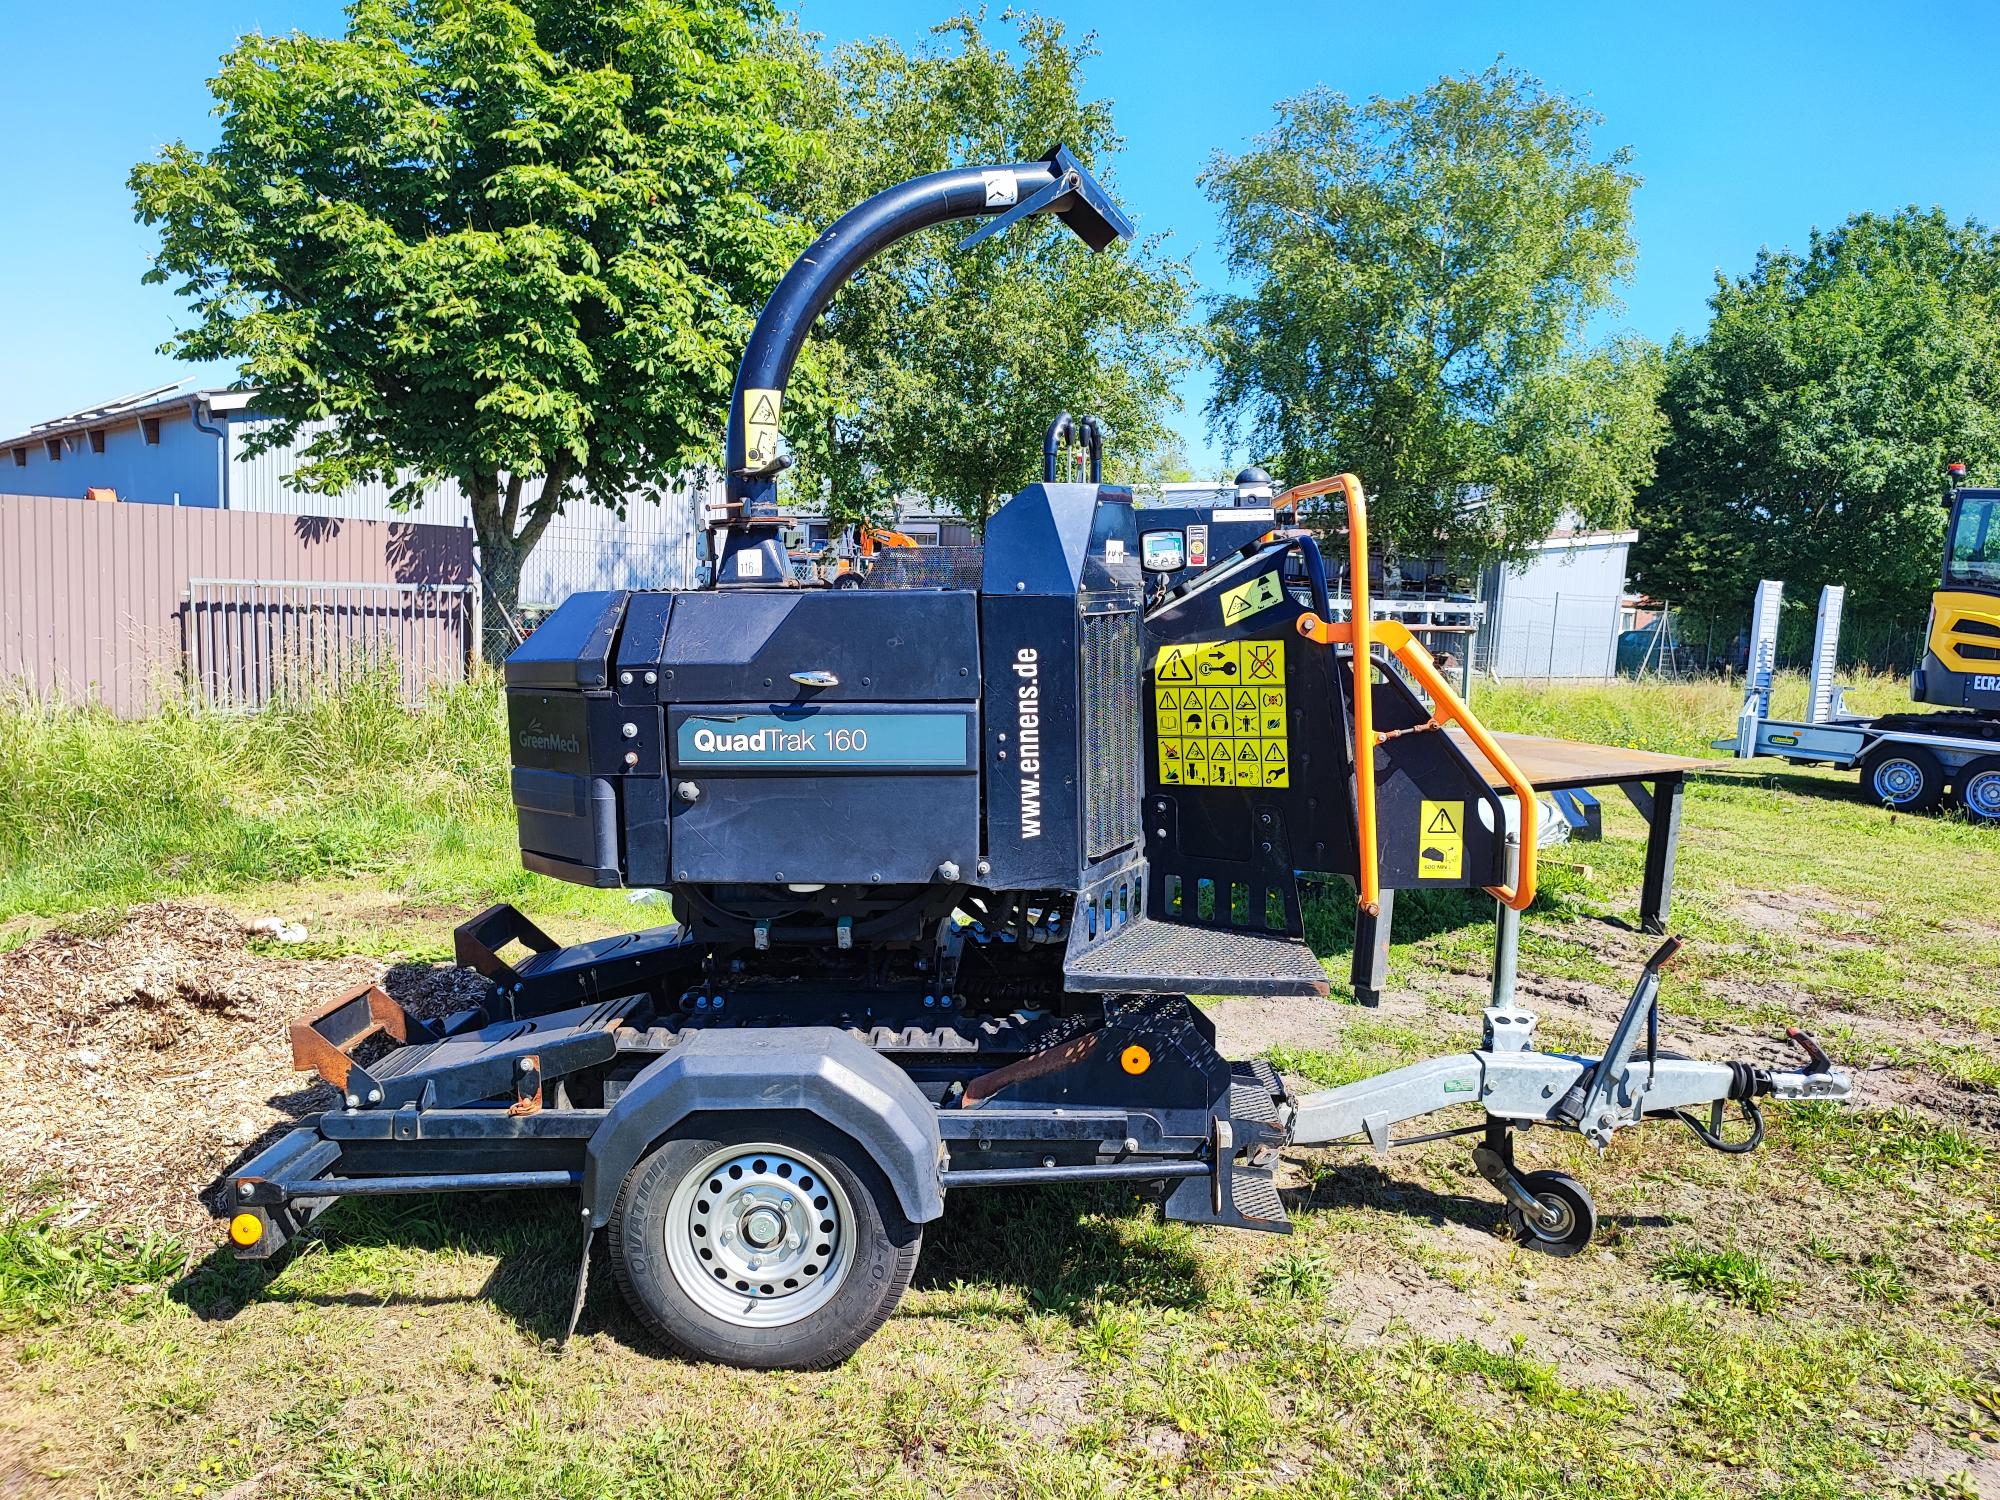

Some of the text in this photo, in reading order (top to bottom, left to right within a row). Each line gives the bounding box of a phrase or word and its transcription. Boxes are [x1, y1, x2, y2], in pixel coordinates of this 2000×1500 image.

[519, 731, 580, 754] GreenMech
[694, 728, 868, 753] QuadTrak 160
[1012, 648, 1041, 839] www.ennens.de
[629, 1153, 670, 1275] OVATION
